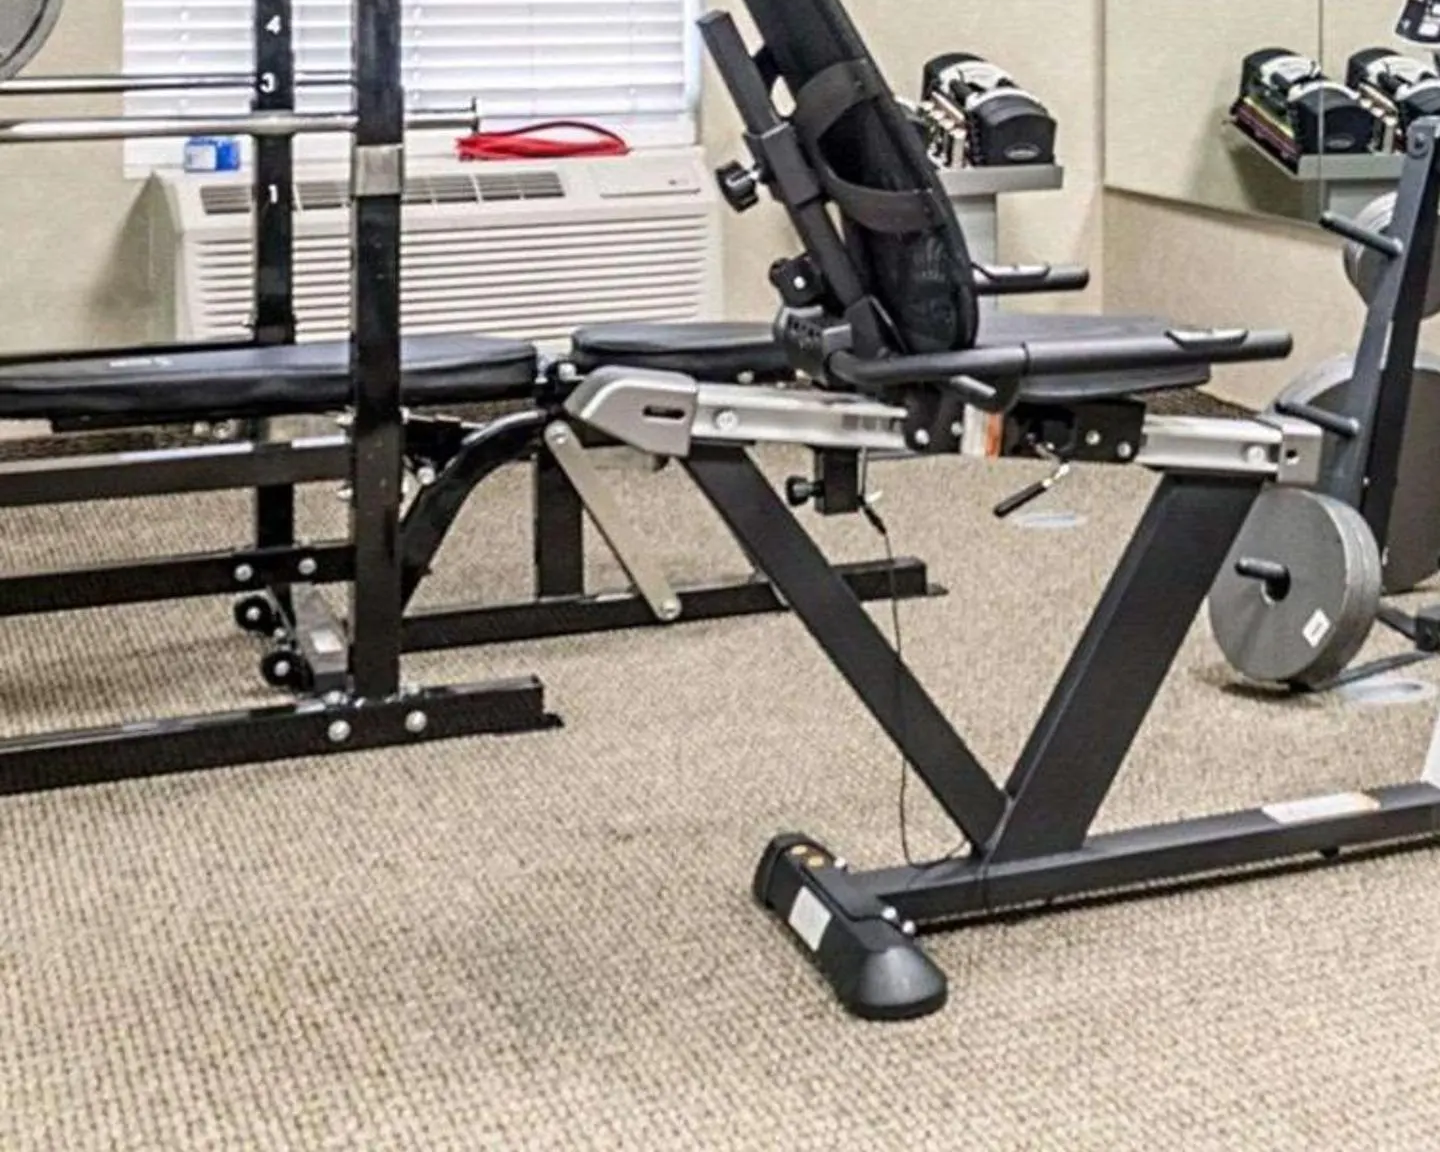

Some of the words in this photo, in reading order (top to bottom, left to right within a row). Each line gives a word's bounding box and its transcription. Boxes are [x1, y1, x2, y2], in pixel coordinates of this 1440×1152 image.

[266, 14, 281, 35] 4
[260, 72, 275, 93] 3
[269, 183, 278, 203] 1
